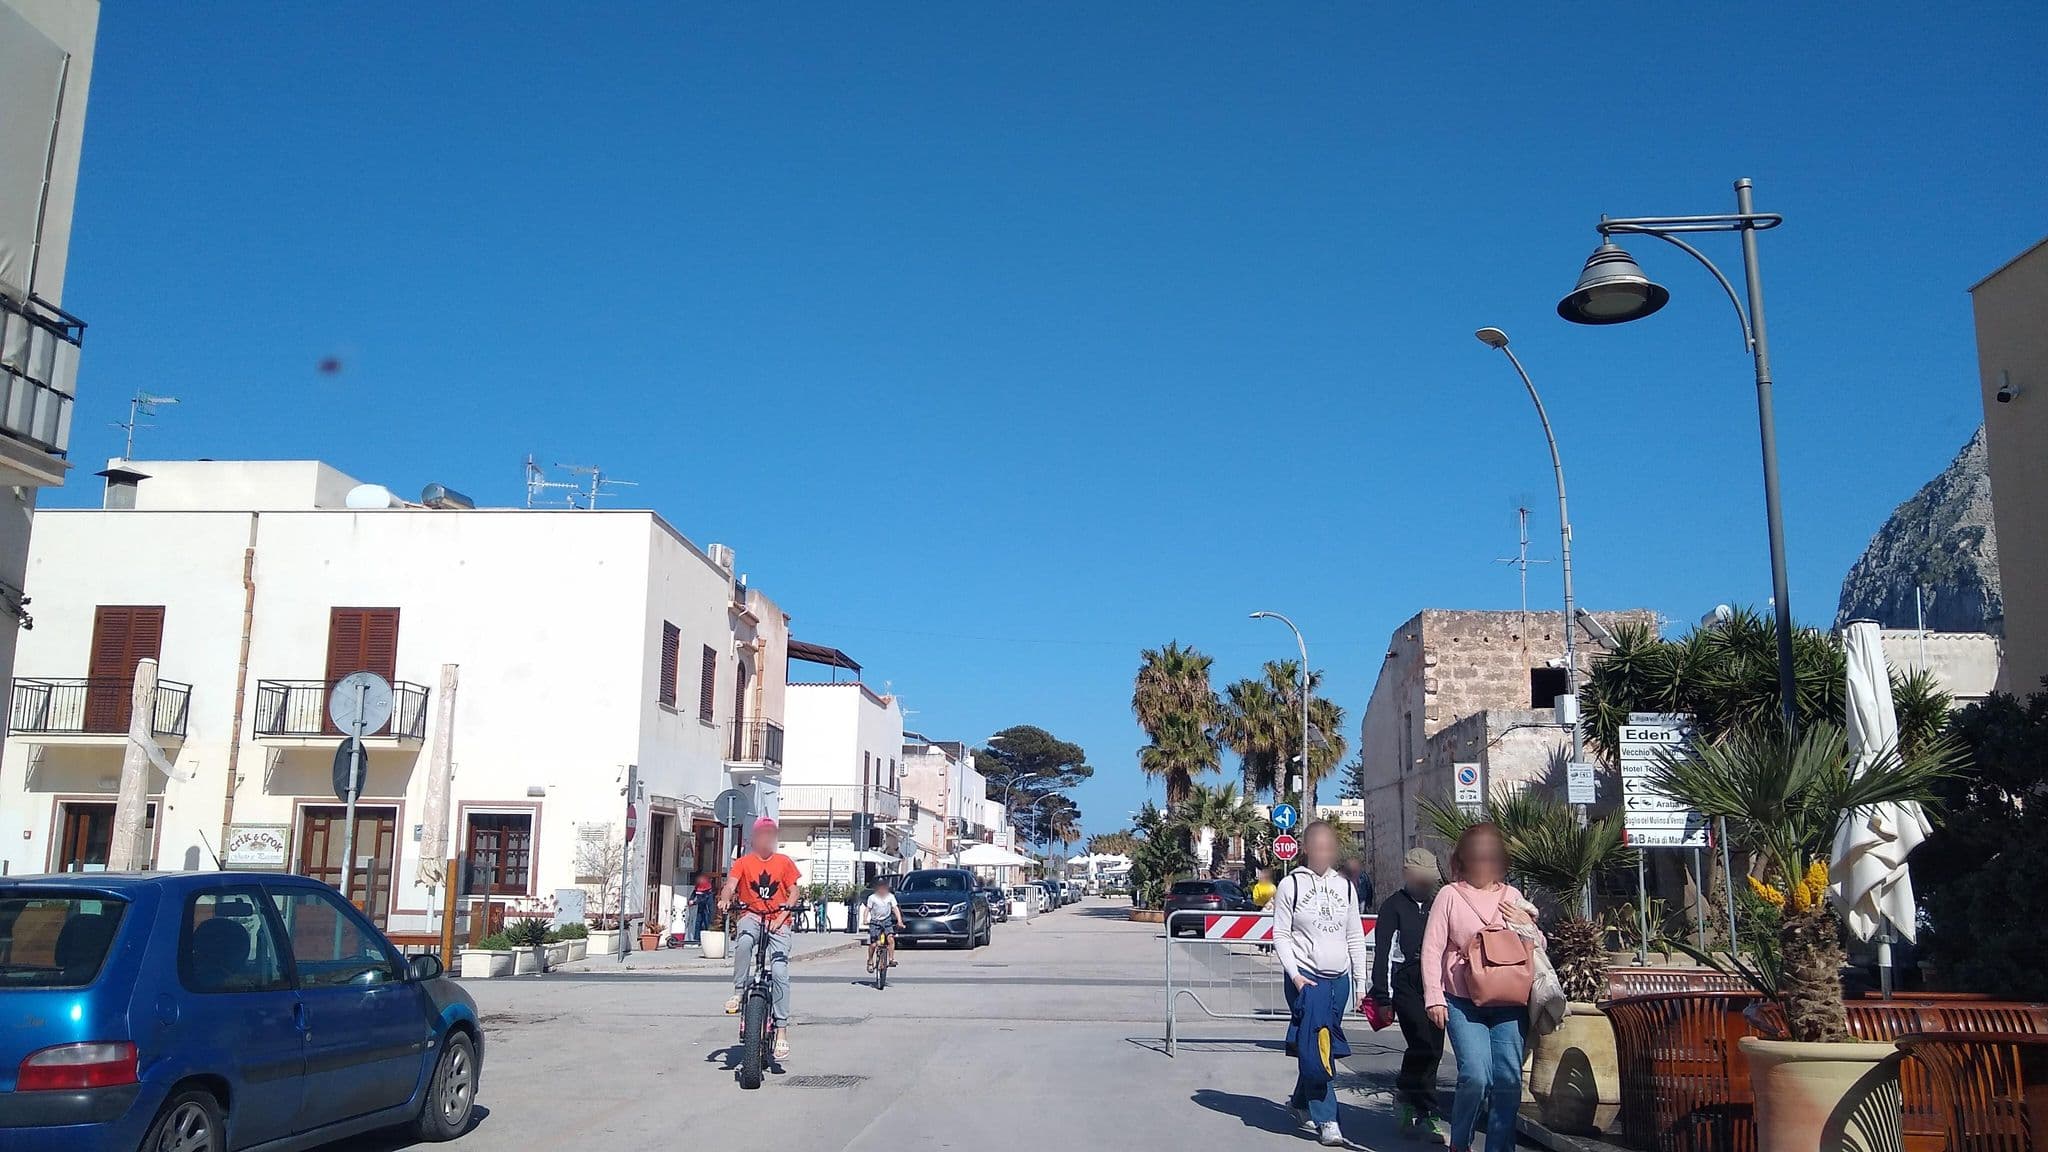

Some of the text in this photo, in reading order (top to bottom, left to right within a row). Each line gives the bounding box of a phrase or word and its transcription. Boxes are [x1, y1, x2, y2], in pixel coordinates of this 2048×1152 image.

[1626, 729, 1671, 740] Eden
[1622, 747, 1650, 756] Vecchio
[1623, 765, 1643, 773] Hotel
[1647, 835, 1660, 844] Aria
[1661, 835, 1668, 844] di
[1275, 842, 1296, 852] STOP
[1302, 885, 1348, 909] NEW JERSEY
[1311, 918, 1345, 934] LEAGUE
